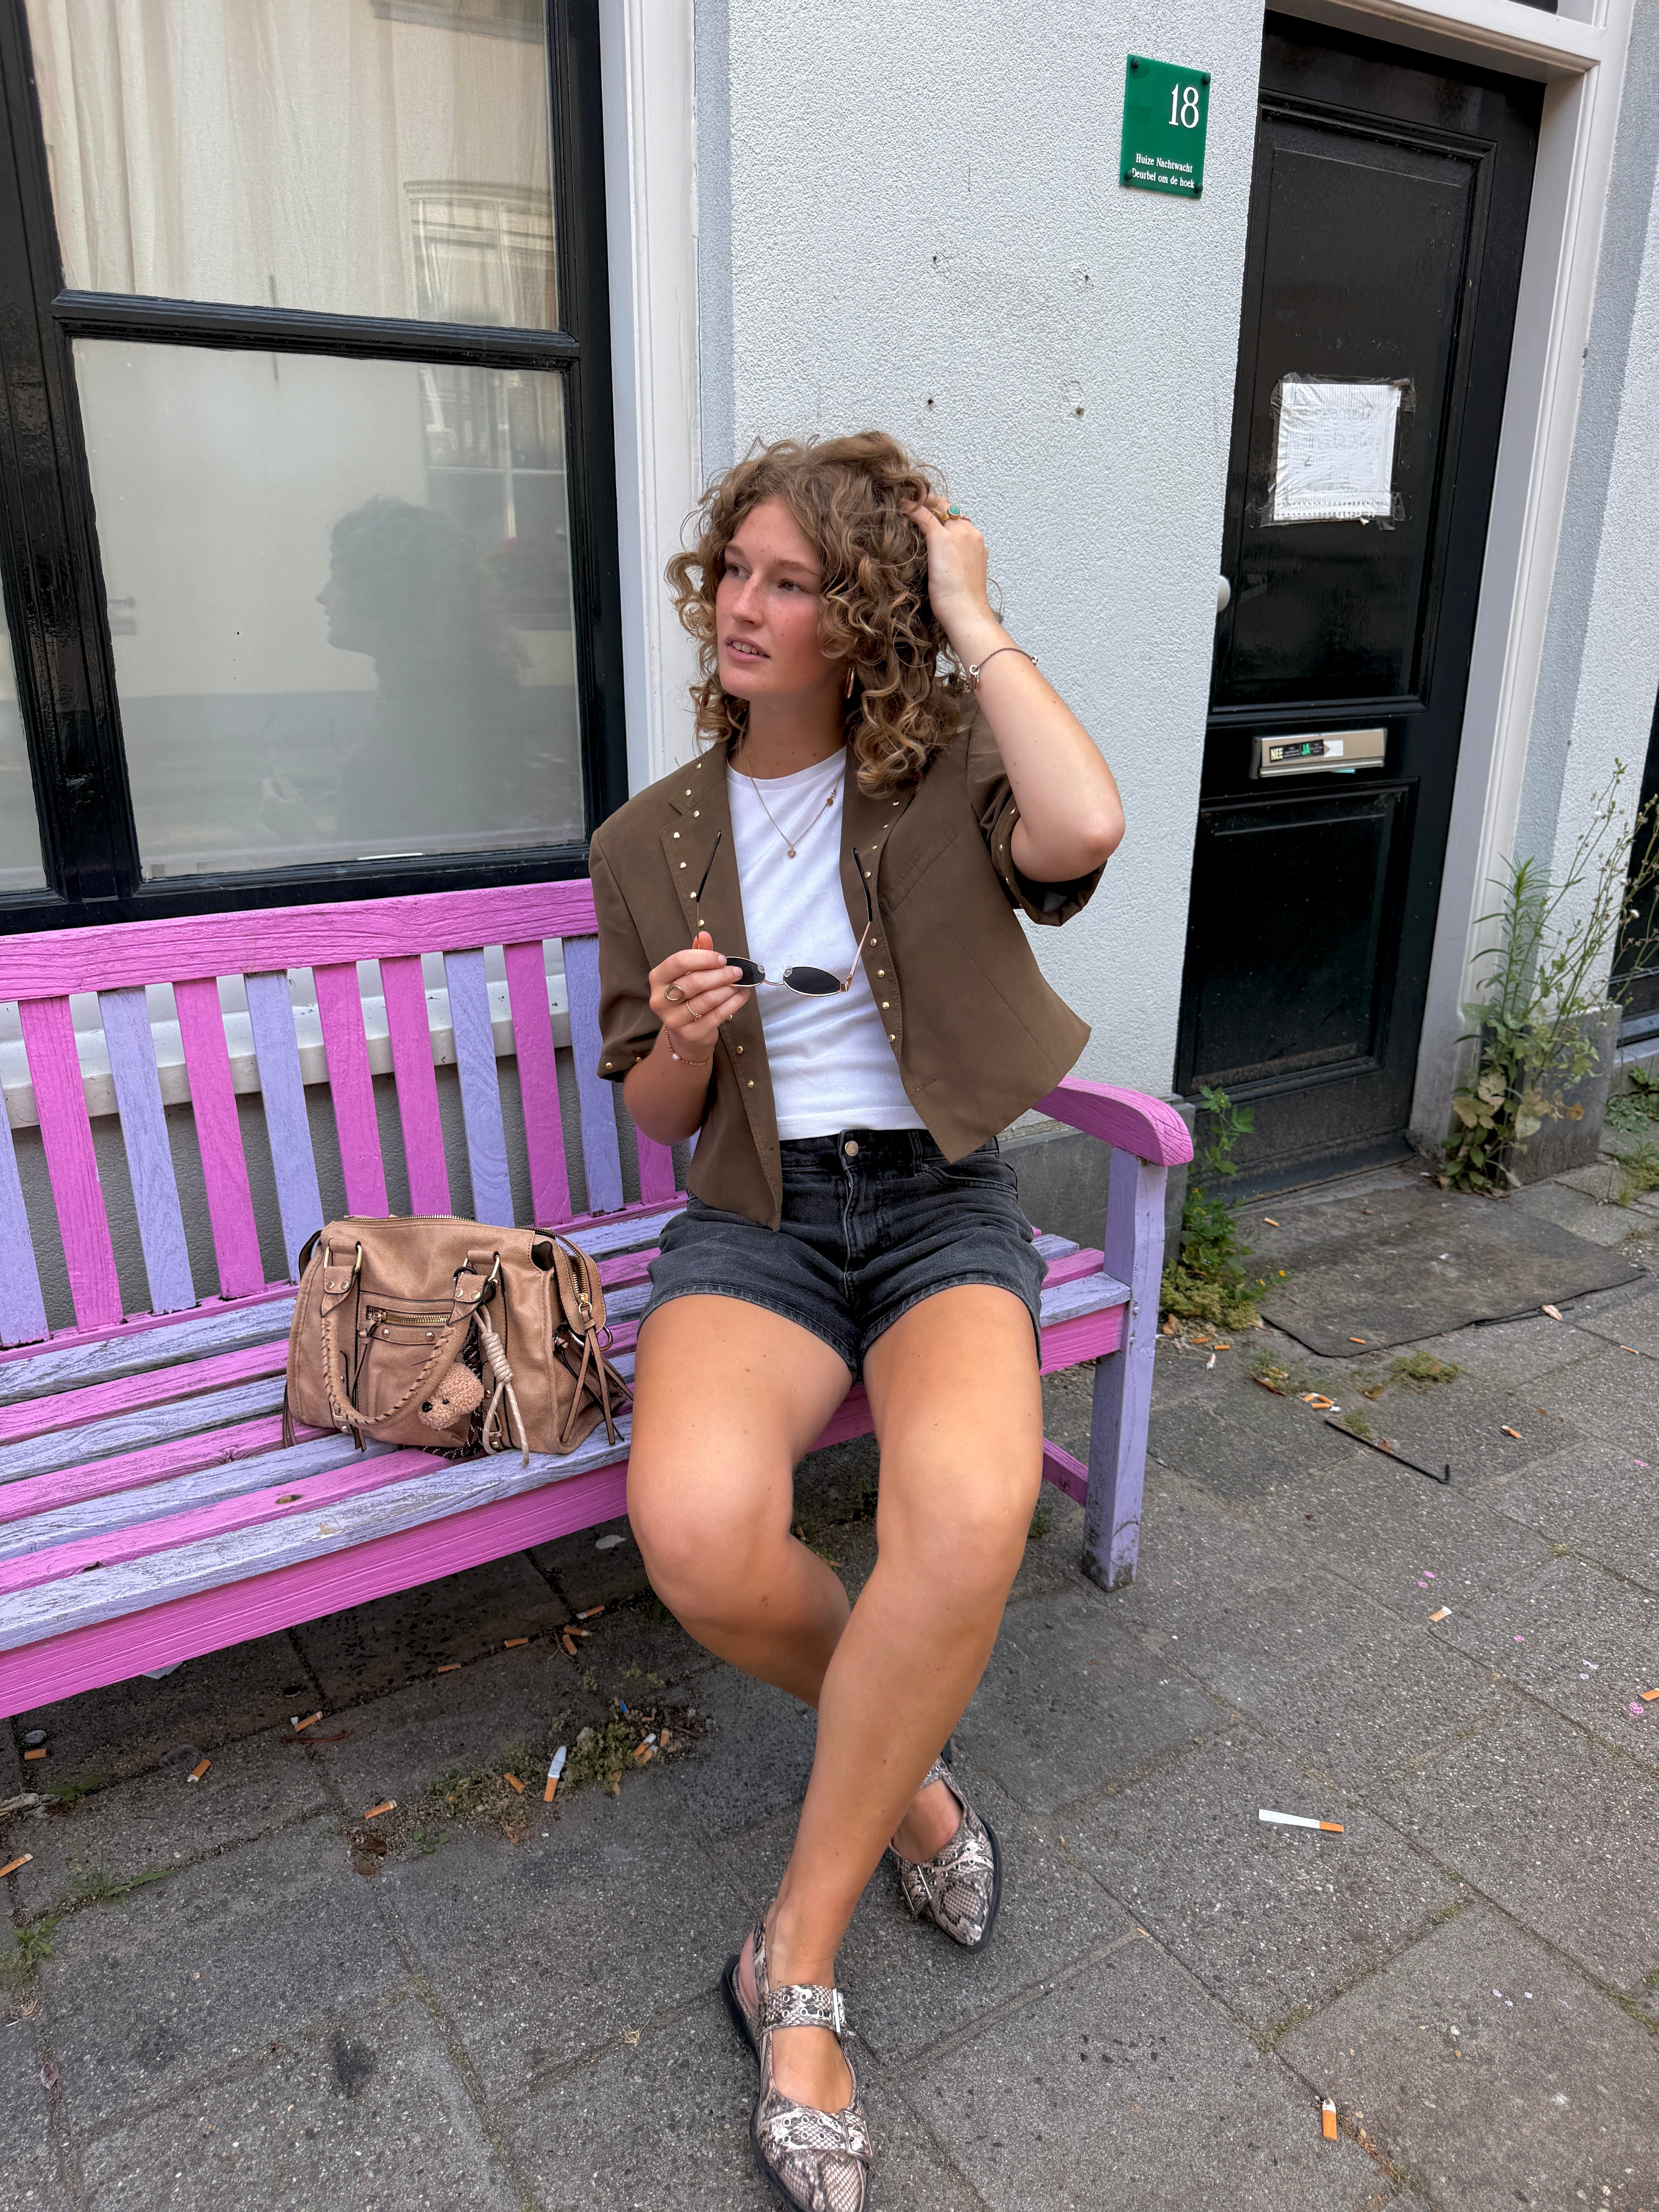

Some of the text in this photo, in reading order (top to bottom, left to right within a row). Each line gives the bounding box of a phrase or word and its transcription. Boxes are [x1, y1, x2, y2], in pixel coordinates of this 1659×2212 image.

[1169, 84, 1199, 128] 18
[1136, 153, 1193, 173] Huize Nachtwacht
[1132, 168, 1195, 188] Deurbel om de hoek
[1271, 747, 1283, 761] NEE
[1301, 743, 1311, 756] JA
